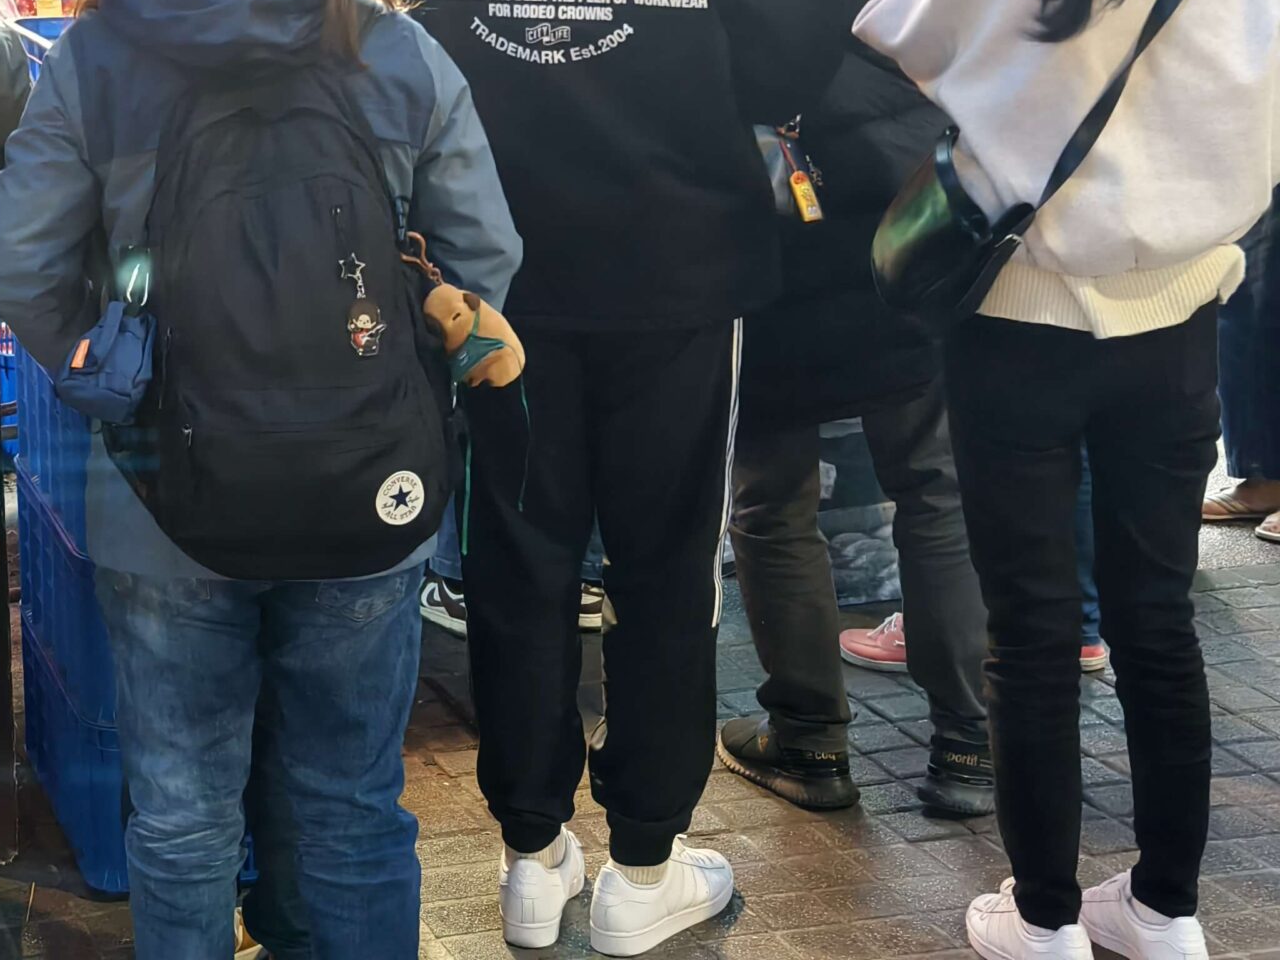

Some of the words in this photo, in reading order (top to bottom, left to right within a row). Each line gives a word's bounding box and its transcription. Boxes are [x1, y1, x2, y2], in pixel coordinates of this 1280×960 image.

[488, 3, 511, 18] FOR
[513, 4, 556, 20] RODEO
[558, 5, 614, 21] CROWNS
[470, 16, 566, 65] TRADEMARK
[570, 23, 635, 62] Est.2004
[382, 475, 418, 496] CONVERSE
